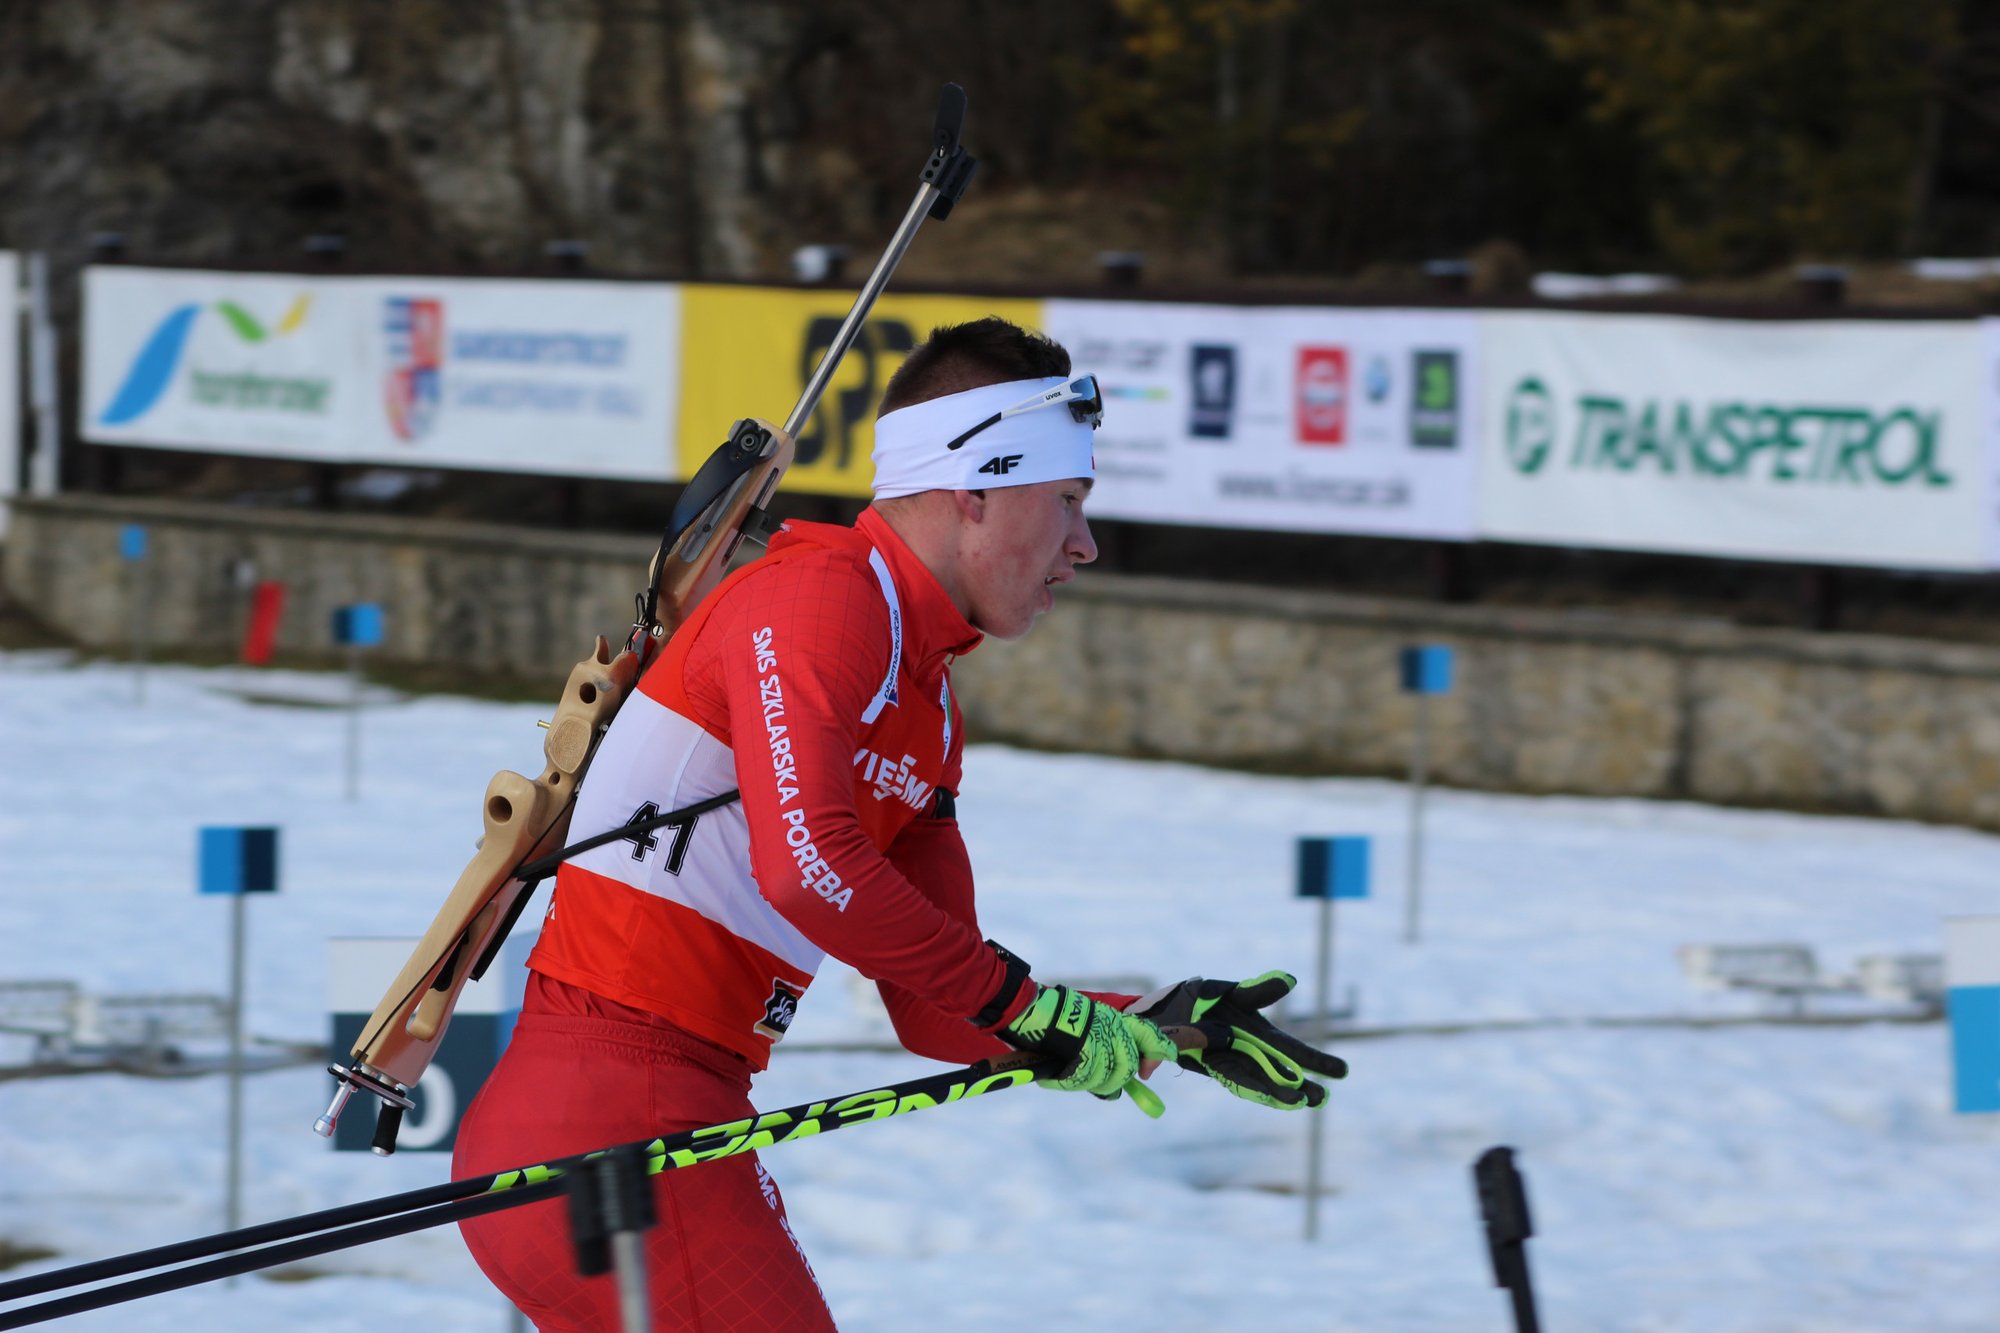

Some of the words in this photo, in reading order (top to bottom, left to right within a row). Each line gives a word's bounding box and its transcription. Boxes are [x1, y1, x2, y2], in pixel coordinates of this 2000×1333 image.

[1045, 391, 1062, 401] uvex
[977, 453, 1024, 475] 4F
[1566, 394, 1954, 488] TRANSPETROL
[752, 626, 778, 673] SMS
[759, 674, 800, 805] SZKLARSKA
[622, 800, 700, 877] 41
[782, 808, 854, 913] PORĘBA
